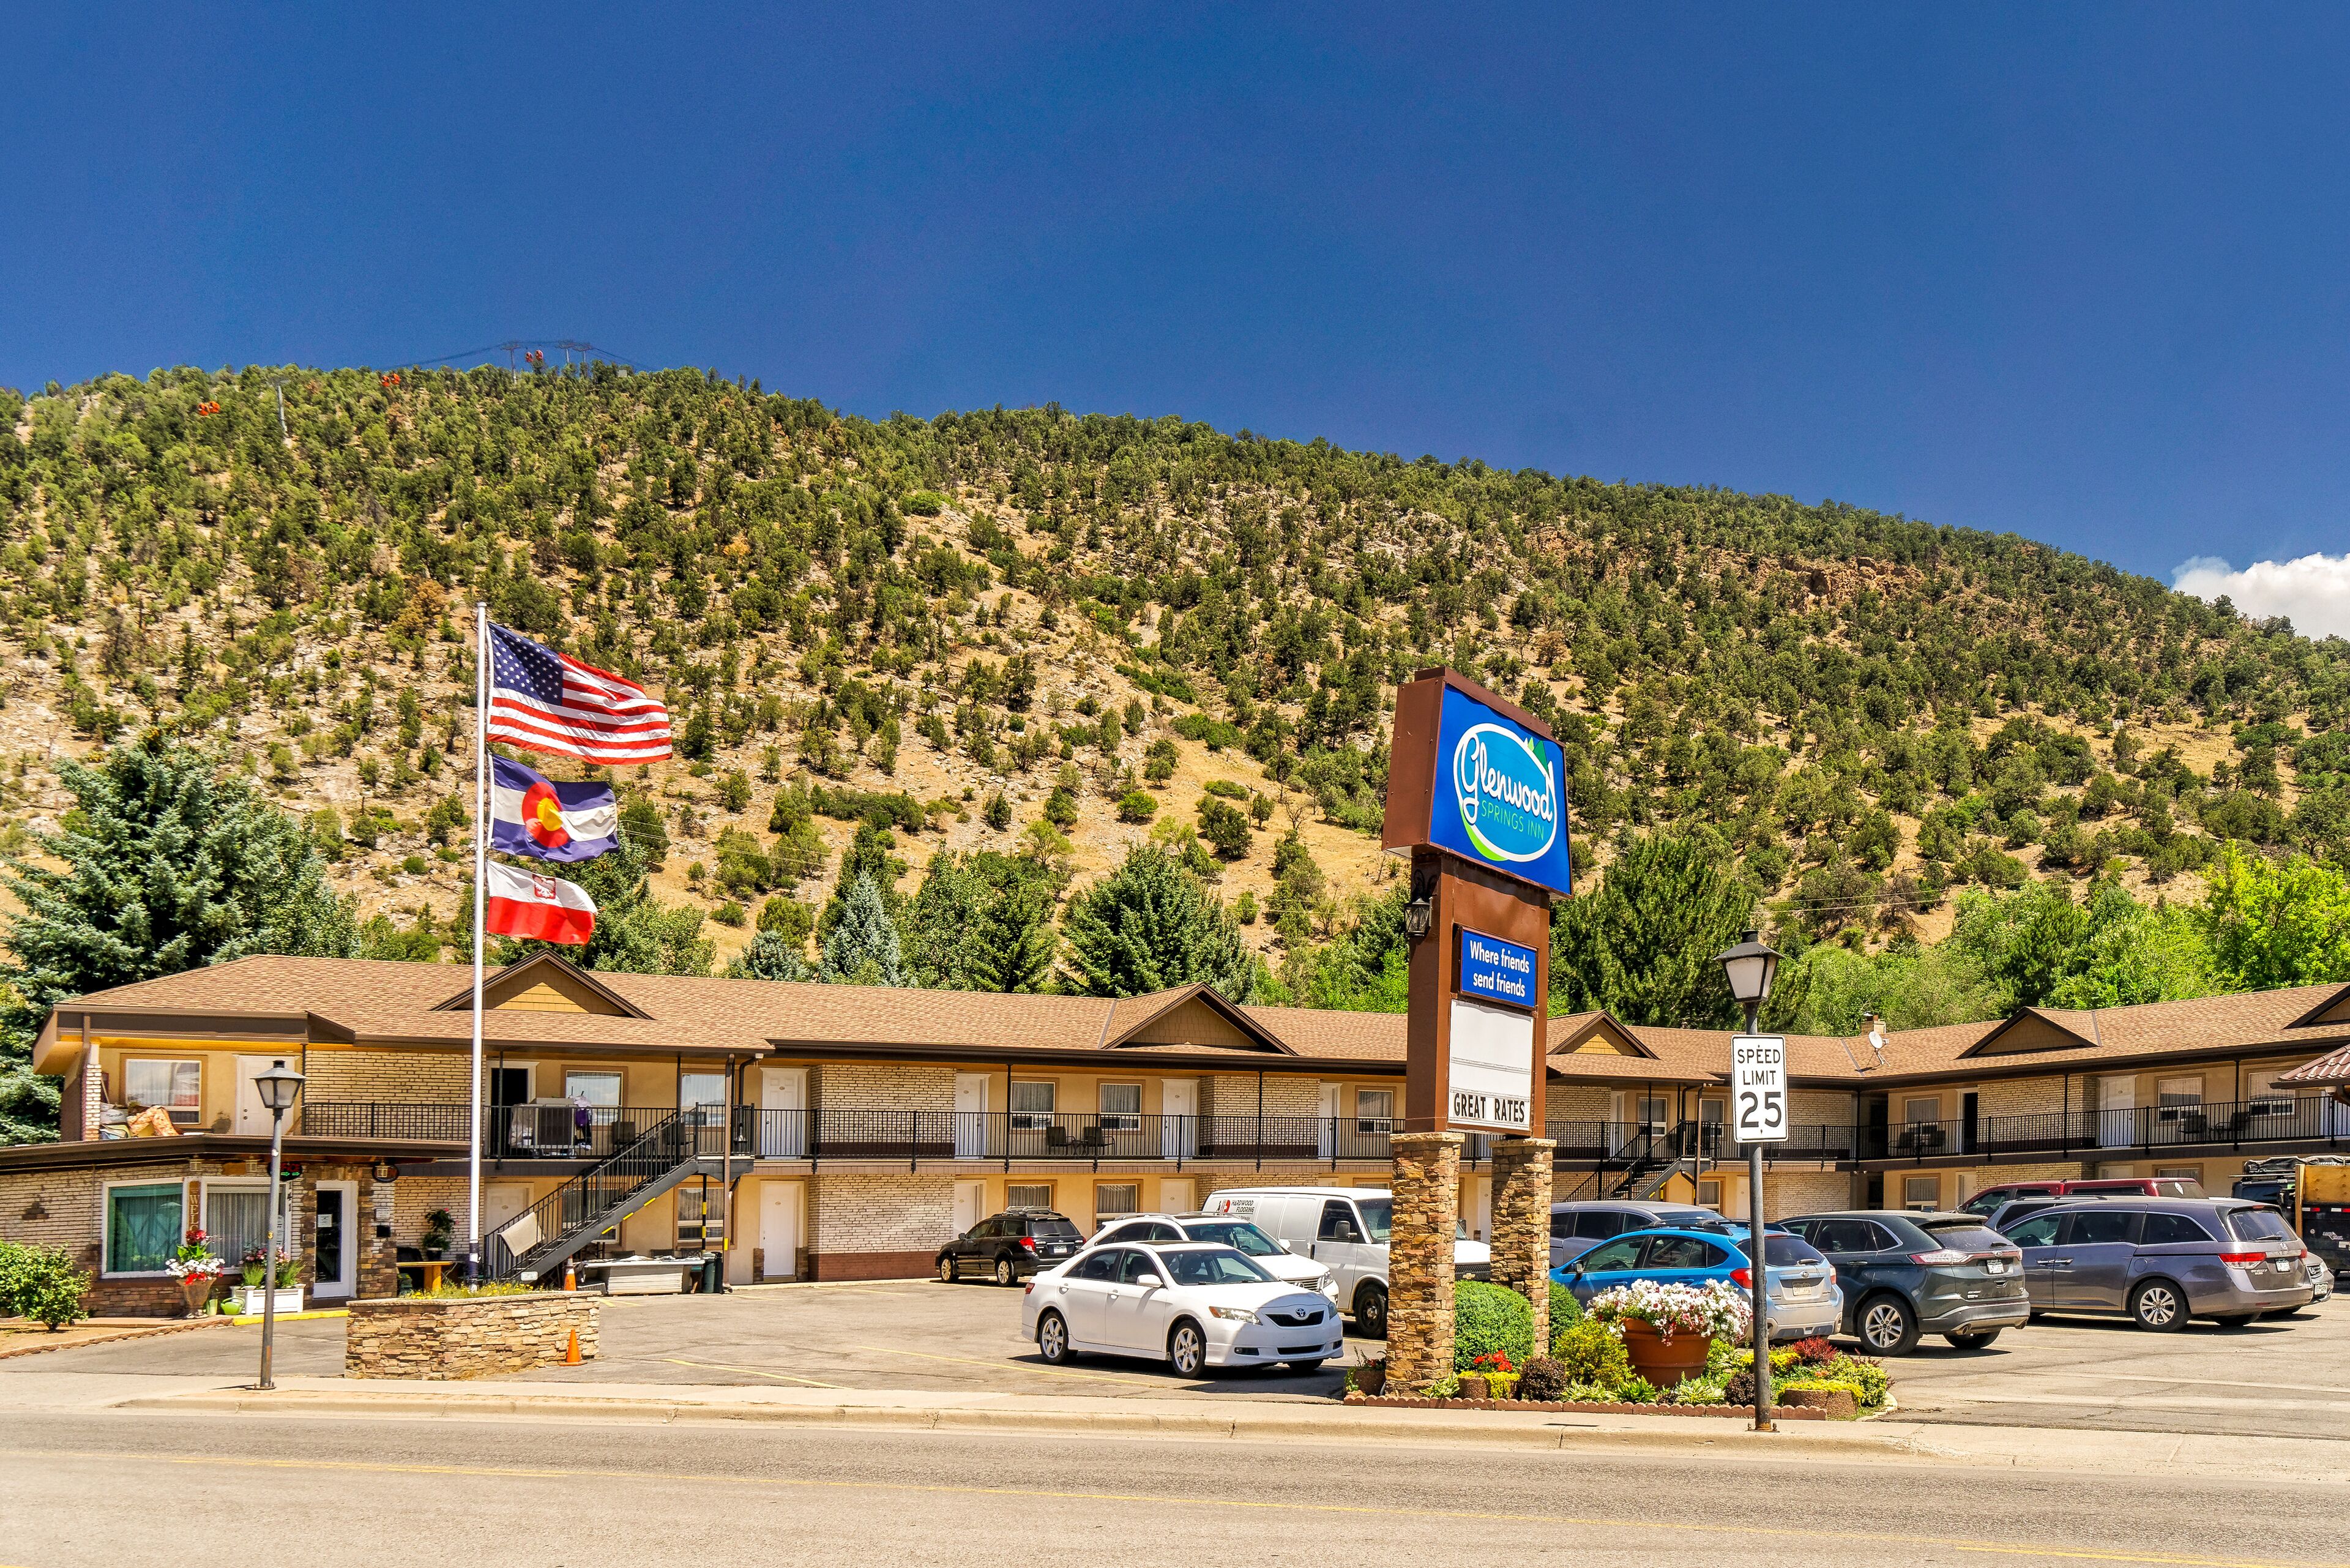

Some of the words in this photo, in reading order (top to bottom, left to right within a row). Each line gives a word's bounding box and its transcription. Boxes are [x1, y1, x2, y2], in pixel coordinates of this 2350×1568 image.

[1461, 734, 1553, 824] Glenwood
[1481, 800, 1523, 832] SPRINGS
[1528, 819, 1544, 840] INN
[1470, 940, 1499, 966] Where
[1501, 948, 1529, 973] friends
[1473, 971, 1494, 990] send
[1496, 973, 1525, 997] friends
[1737, 1048, 1780, 1064] SPEED
[1743, 1070, 1776, 1085] LIMIT
[1454, 1092, 1486, 1119] GREAT
[1494, 1098, 1524, 1122] RATES
[1739, 1091, 1782, 1128] 25
